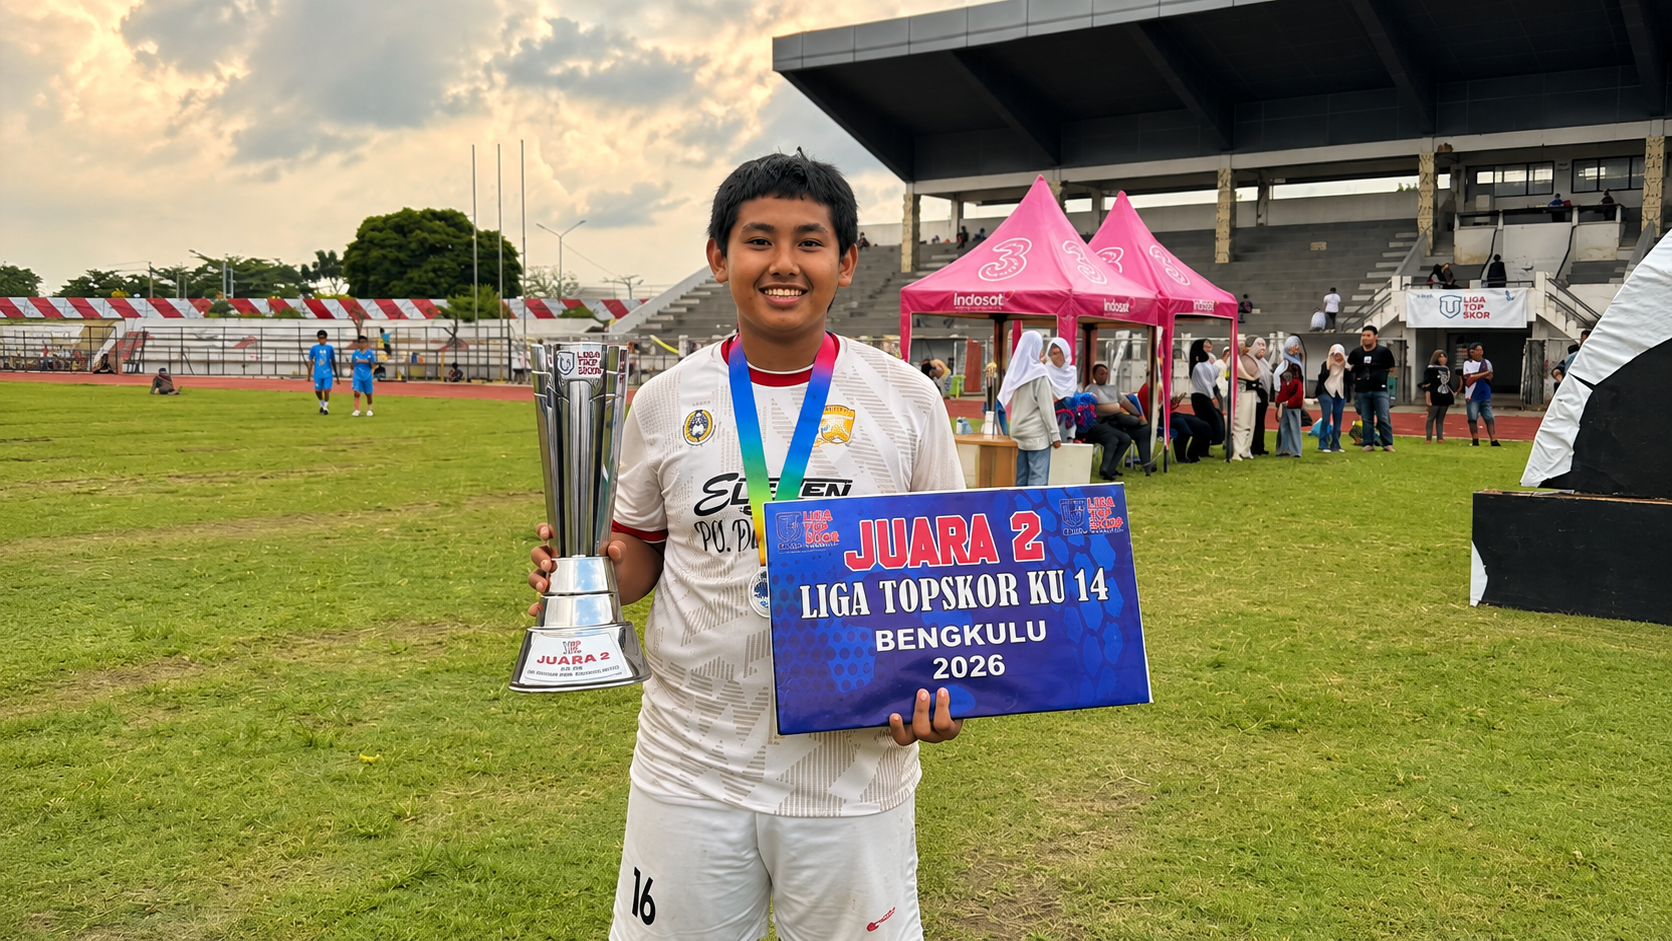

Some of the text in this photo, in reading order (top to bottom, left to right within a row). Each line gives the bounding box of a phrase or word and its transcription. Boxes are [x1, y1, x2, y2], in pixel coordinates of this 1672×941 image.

[953, 292, 1004, 306] Indosat
[1103, 298, 1130, 313] Indosat
[1463, 303, 1484, 312] TOP
[1463, 311, 1490, 319] SKOR
[844, 510, 1046, 572] JUARA 2
[799, 566, 1110, 620] LIGA TOPSKOR KU 14
[875, 620, 1047, 652] BENGKULU
[536, 652, 611, 666] JUARA 2
[932, 654, 1006, 680] 2026
[631, 866, 656, 926] 16
